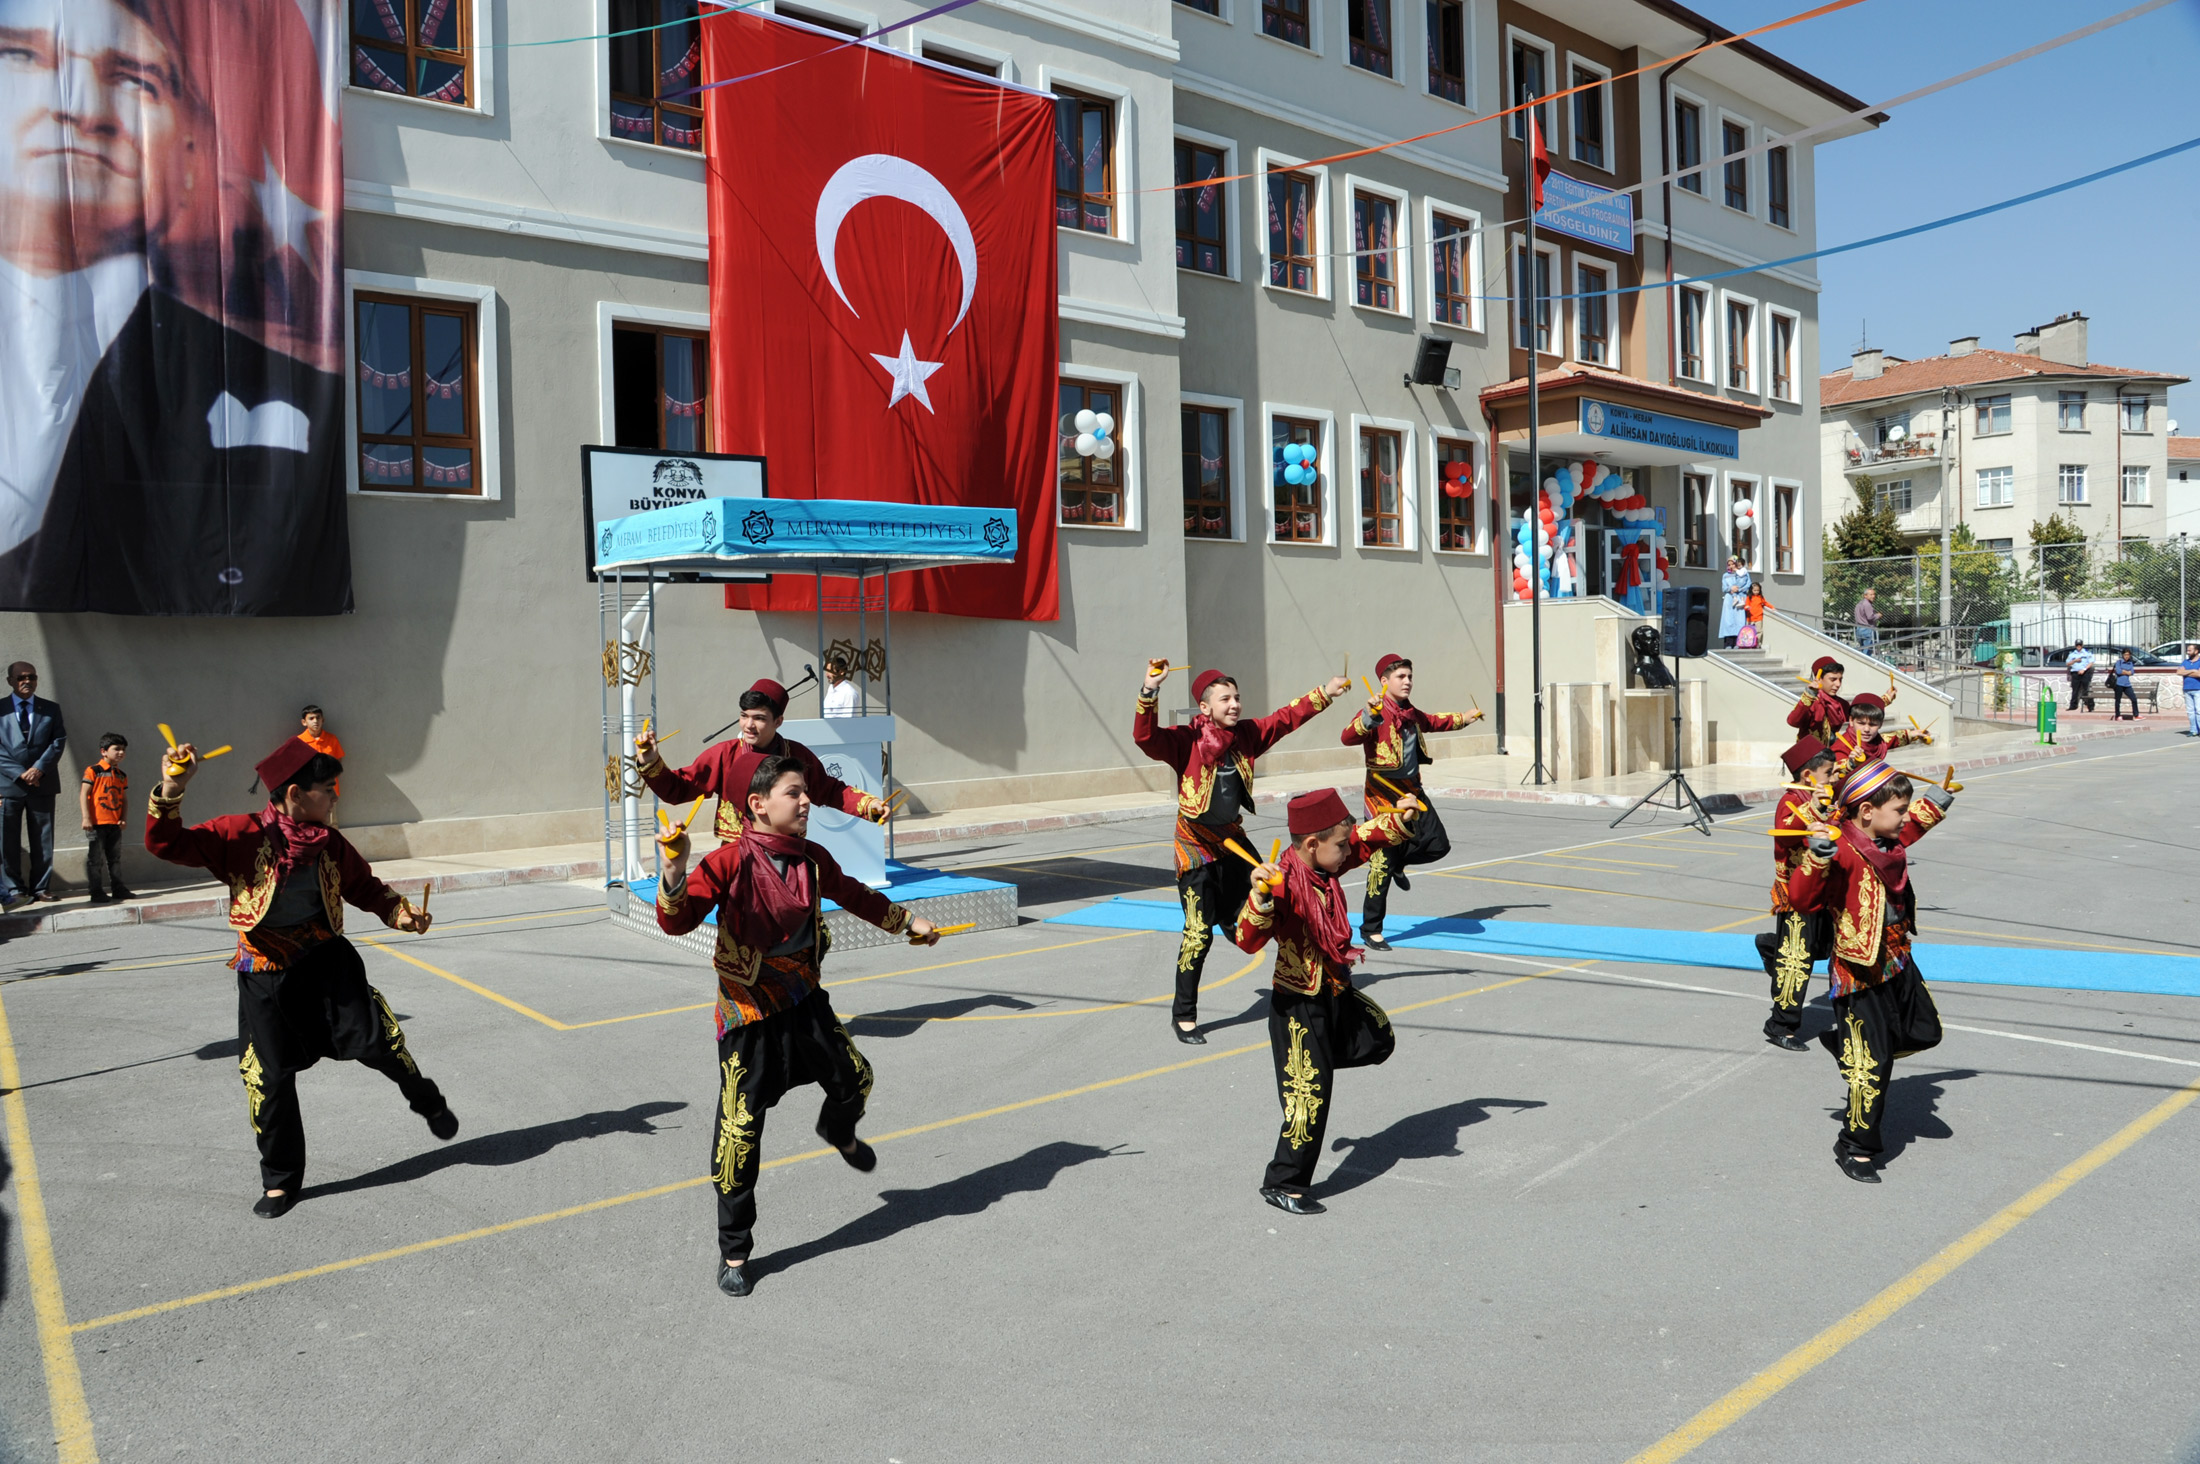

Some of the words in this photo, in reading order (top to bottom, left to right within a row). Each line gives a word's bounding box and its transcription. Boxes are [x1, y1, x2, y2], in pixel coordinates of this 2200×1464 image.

[1565, 181, 1585, 199] EĞİTİM
[1544, 209, 1620, 243] HOŞGELDİNİZ
[1591, 207, 1629, 228] PROGRAMINA
[1610, 407, 1628, 419] KONYA
[1633, 414, 1652, 424] MERAM
[1610, 421, 1648, 442] ALİİHSAN
[1649, 431, 1697, 451] DAYIOĞLUGİL
[1699, 436, 1734, 456] İLKOKULU
[653, 487, 707, 499] KONYA
[630, 497, 693, 511] BÜYÜ
[616, 531, 642, 547] MERAM
[647, 519, 697, 543] BELEDİYESİ
[787, 520, 852, 537] MERAM
[868, 520, 973, 540] BELEDİYESİ
